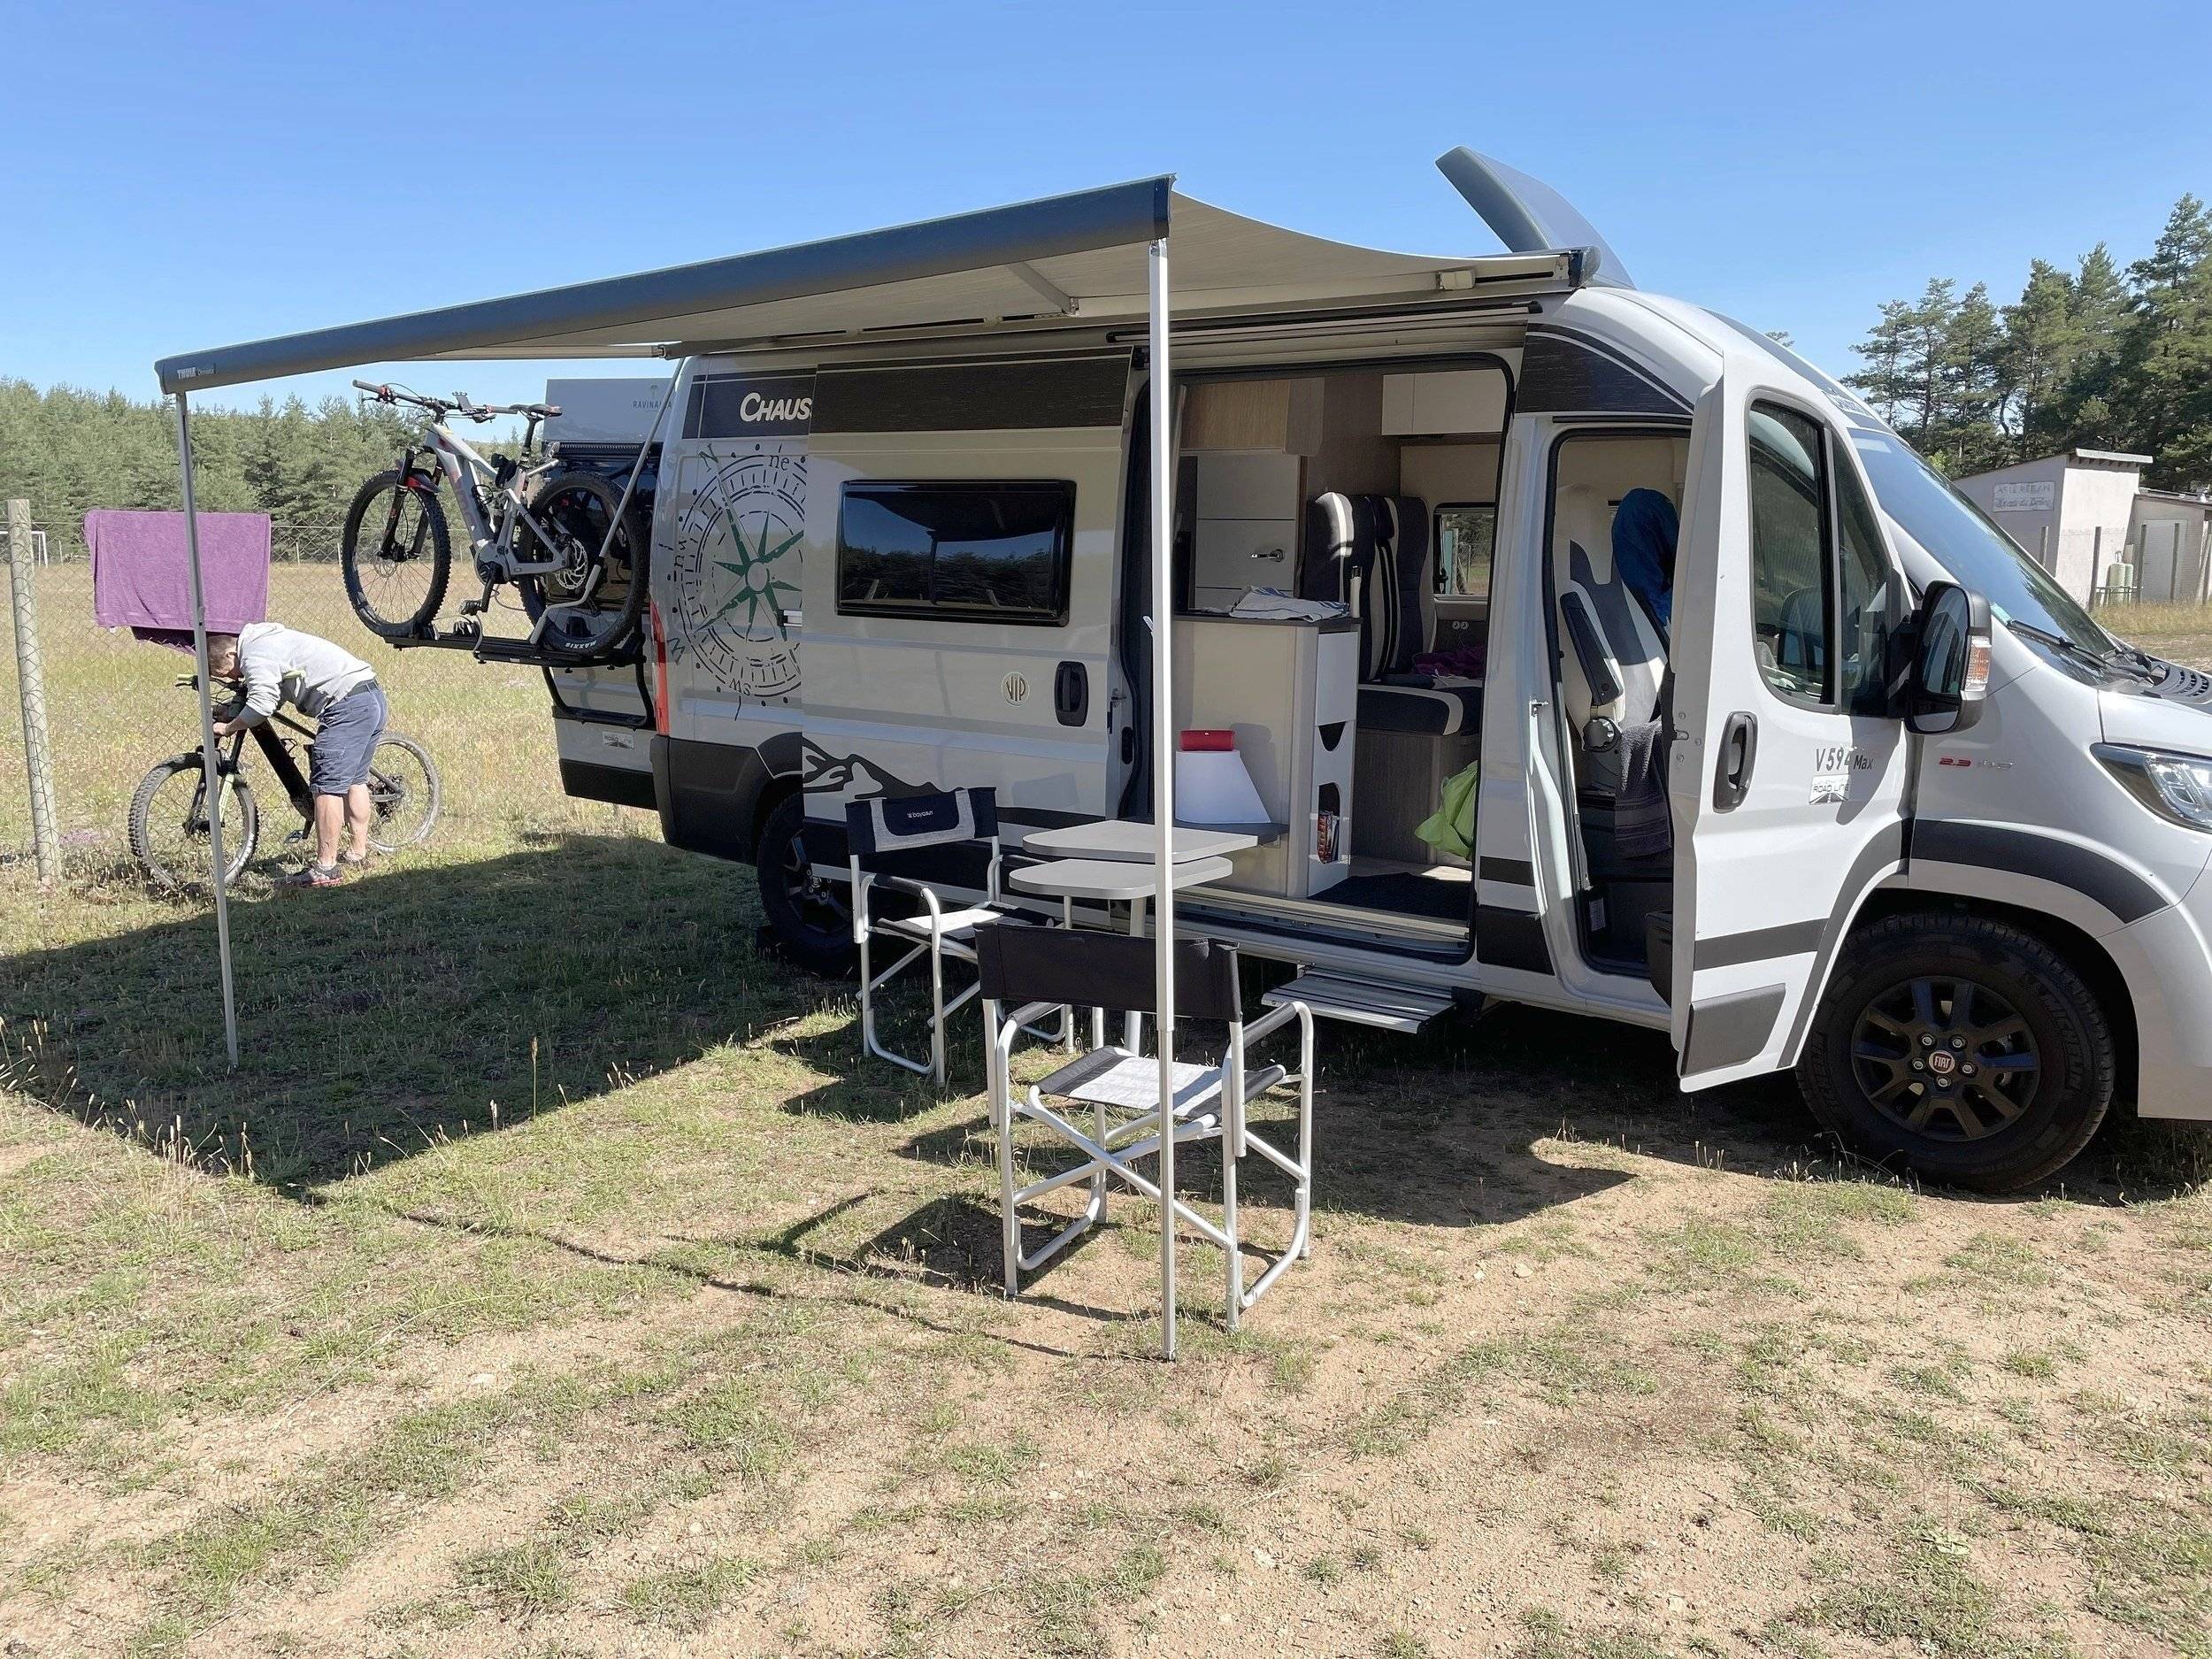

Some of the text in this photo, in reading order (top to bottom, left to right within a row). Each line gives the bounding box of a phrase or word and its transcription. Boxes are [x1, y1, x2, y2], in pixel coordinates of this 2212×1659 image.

[740, 392, 812, 422] CHAUS
[769, 455, 790, 471] ne
[1816, 748, 1826, 772] V
[1853, 755, 1875, 770] Max
[1935, 1056, 1951, 1069] FIAT
